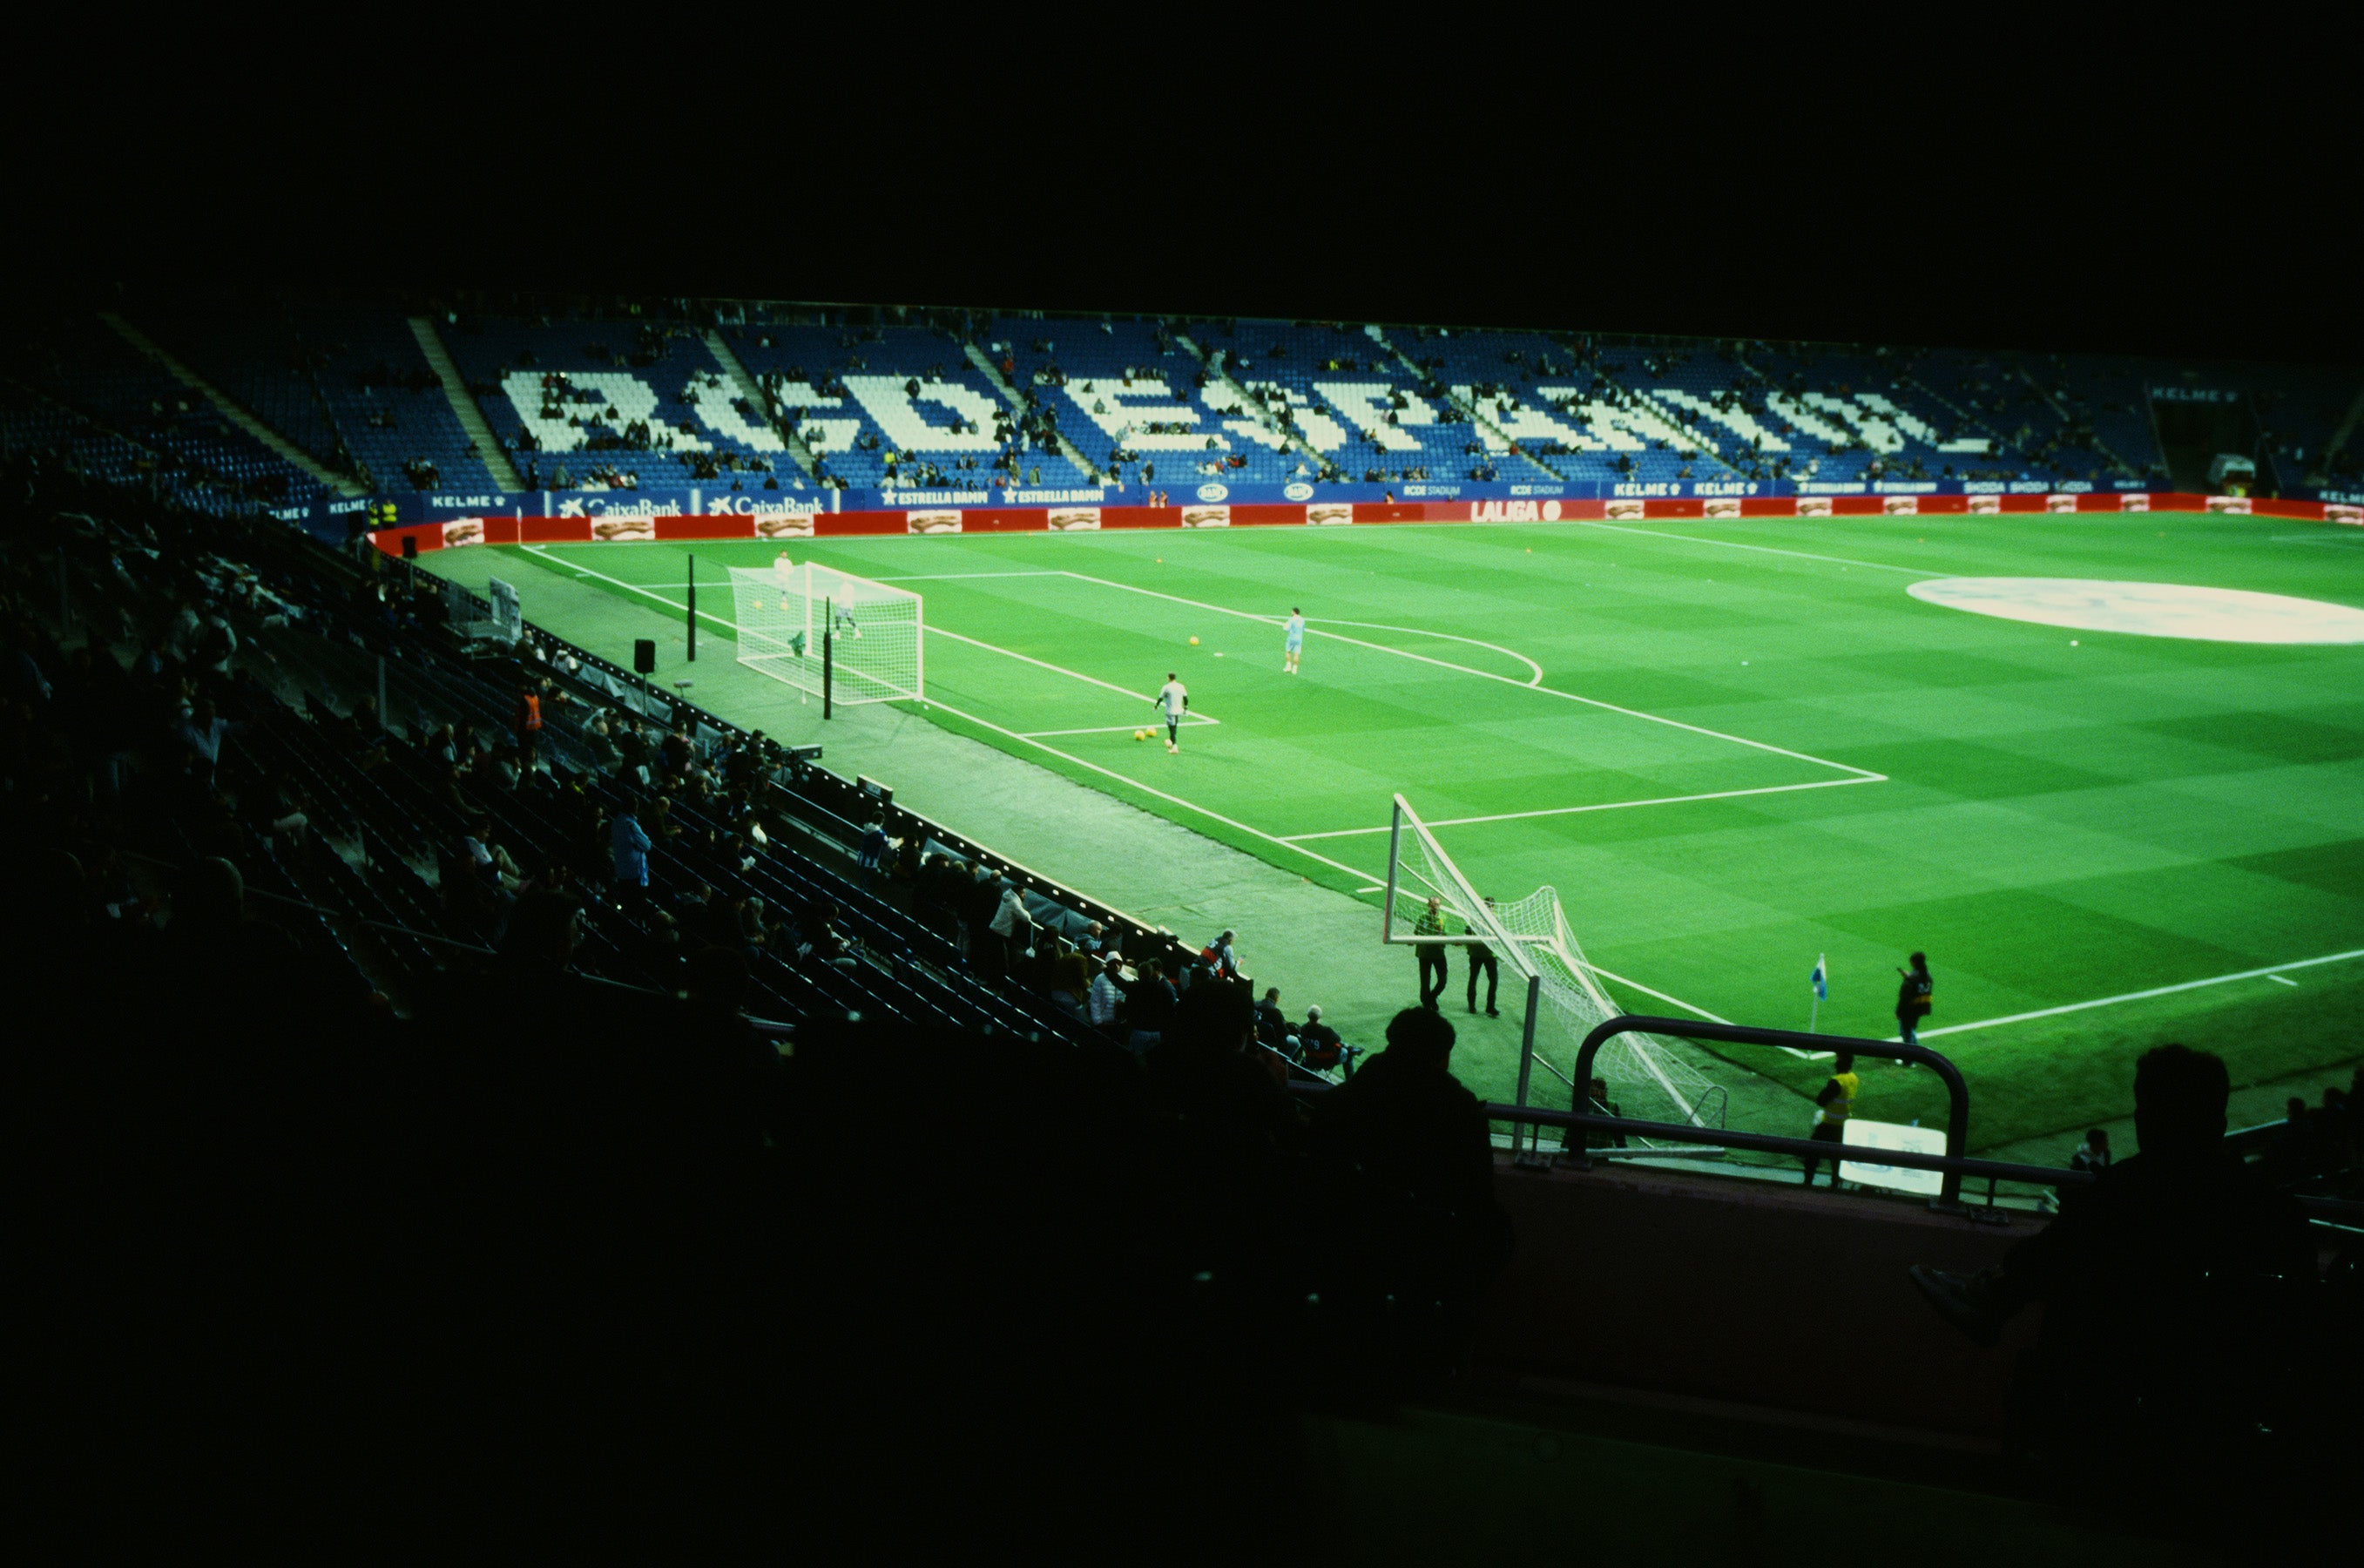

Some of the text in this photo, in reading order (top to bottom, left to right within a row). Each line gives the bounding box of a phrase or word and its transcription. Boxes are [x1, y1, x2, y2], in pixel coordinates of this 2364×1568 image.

[502, 371, 1002, 453] RCD
[1018, 489, 1104, 503] ESTRELLA DAMM
[1428, 485, 1461, 497] STADIUM
[1614, 483, 1668, 497] KELME
[1694, 483, 1746, 496] KELME
[432, 496, 490, 508] KELME
[898, 490, 989, 504] ESTRELLA DAMM
[329, 498, 367, 515] KELME
[588, 498, 682, 517] CaixaBank
[734, 496, 824, 516] CaixaBank
[1470, 500, 1539, 523] LALIGA
